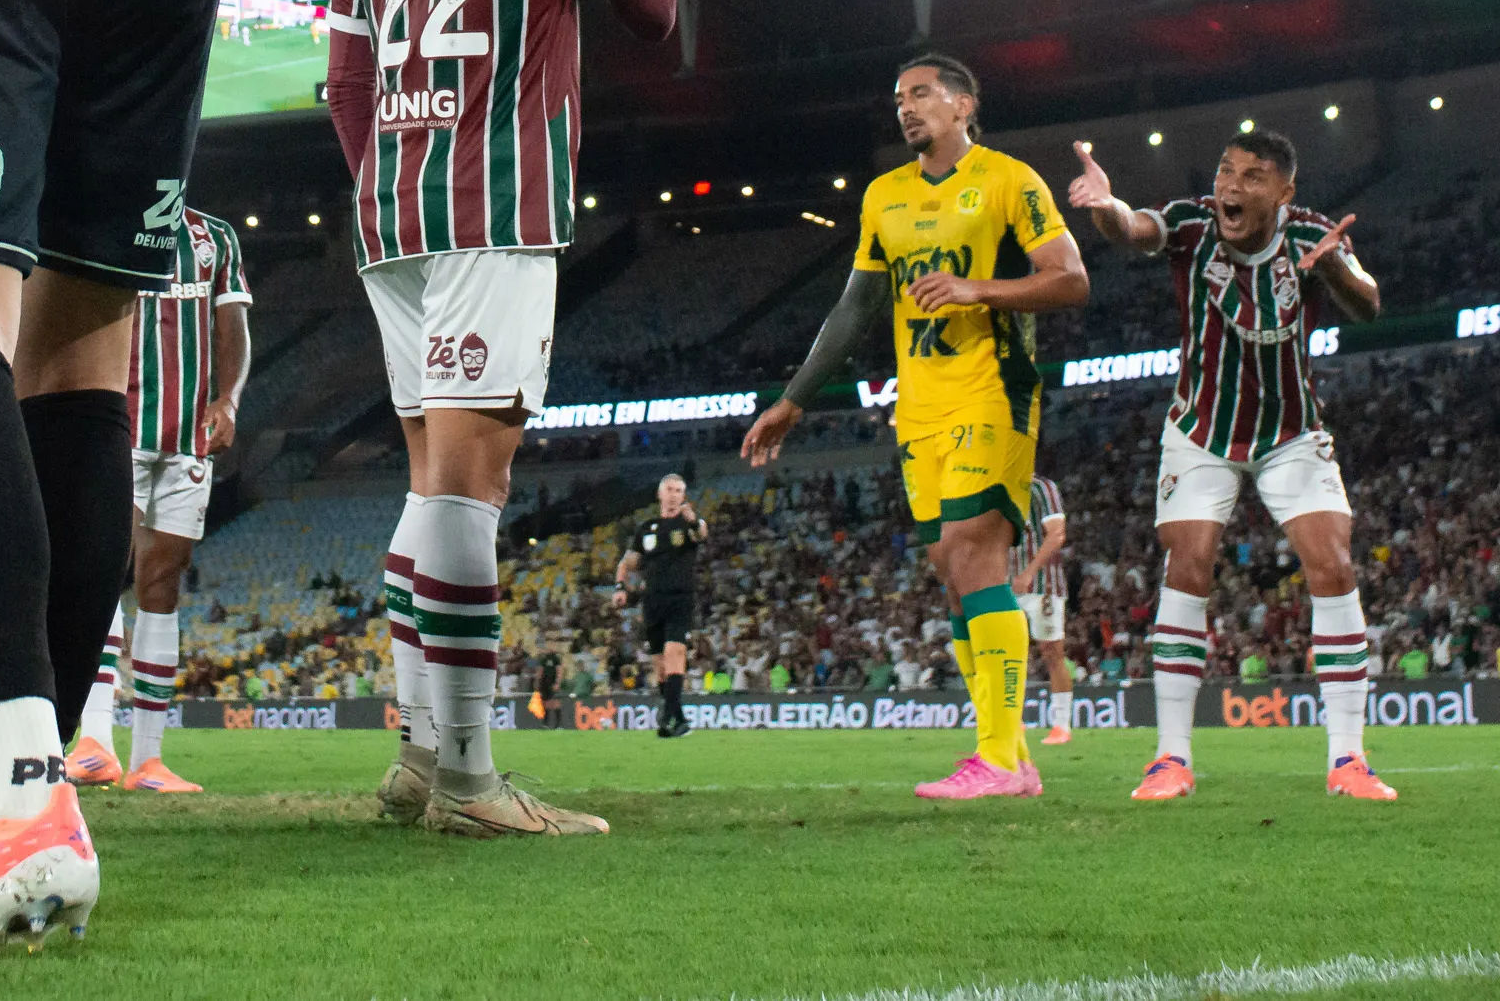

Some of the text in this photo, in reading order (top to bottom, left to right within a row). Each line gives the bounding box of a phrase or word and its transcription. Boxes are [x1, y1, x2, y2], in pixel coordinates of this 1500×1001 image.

[381, 89, 455, 121] UNIG
[426, 335, 457, 369] Zé
[425, 371, 457, 380] DELIVERY
[223, 697, 337, 729] betnacional
[683, 696, 867, 729] BRASILEIRÃO
[873, 698, 959, 728] Betano
